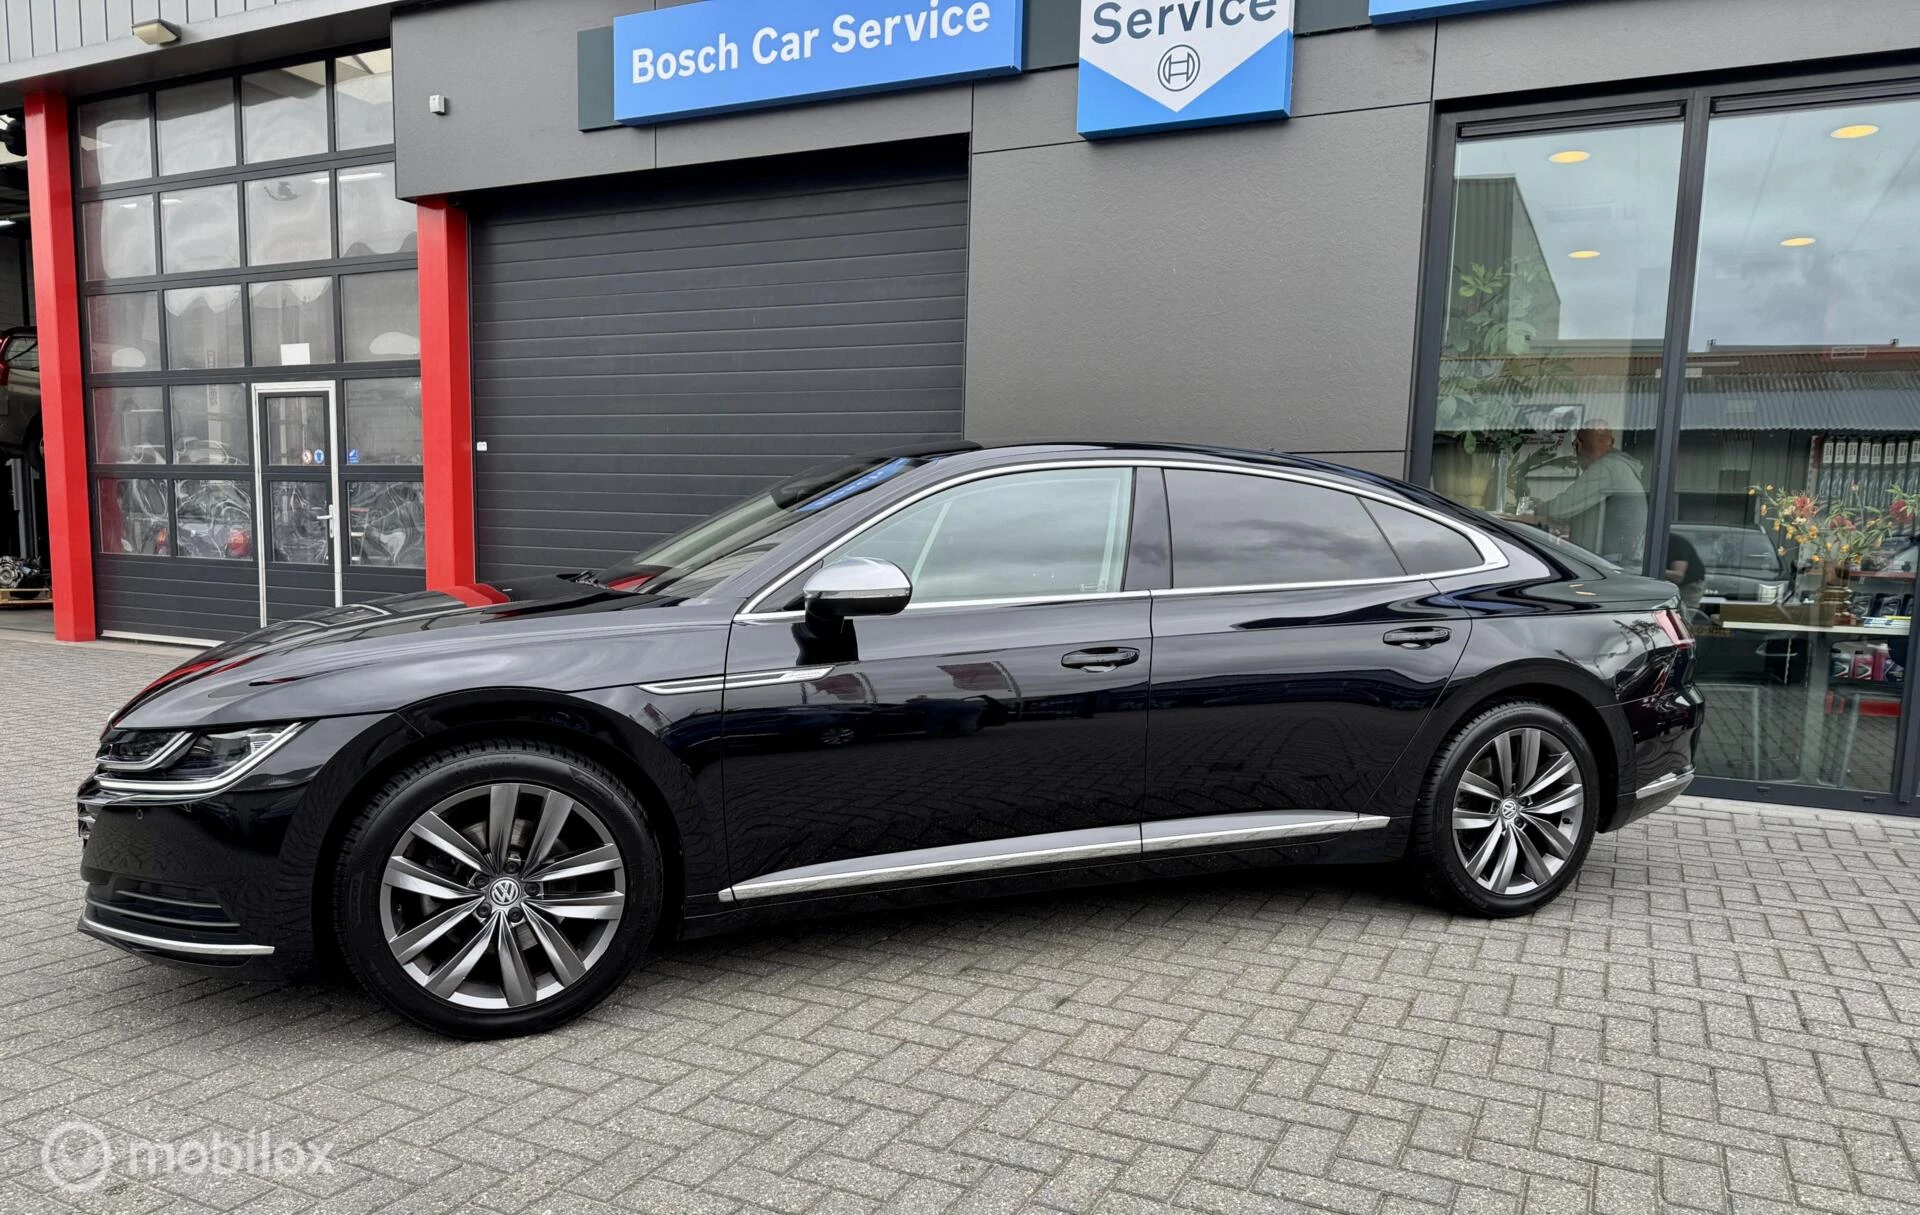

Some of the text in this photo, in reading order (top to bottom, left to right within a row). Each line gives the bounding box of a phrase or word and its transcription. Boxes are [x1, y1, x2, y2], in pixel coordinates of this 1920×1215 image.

[632, 0, 991, 84] Bosch Car Service
